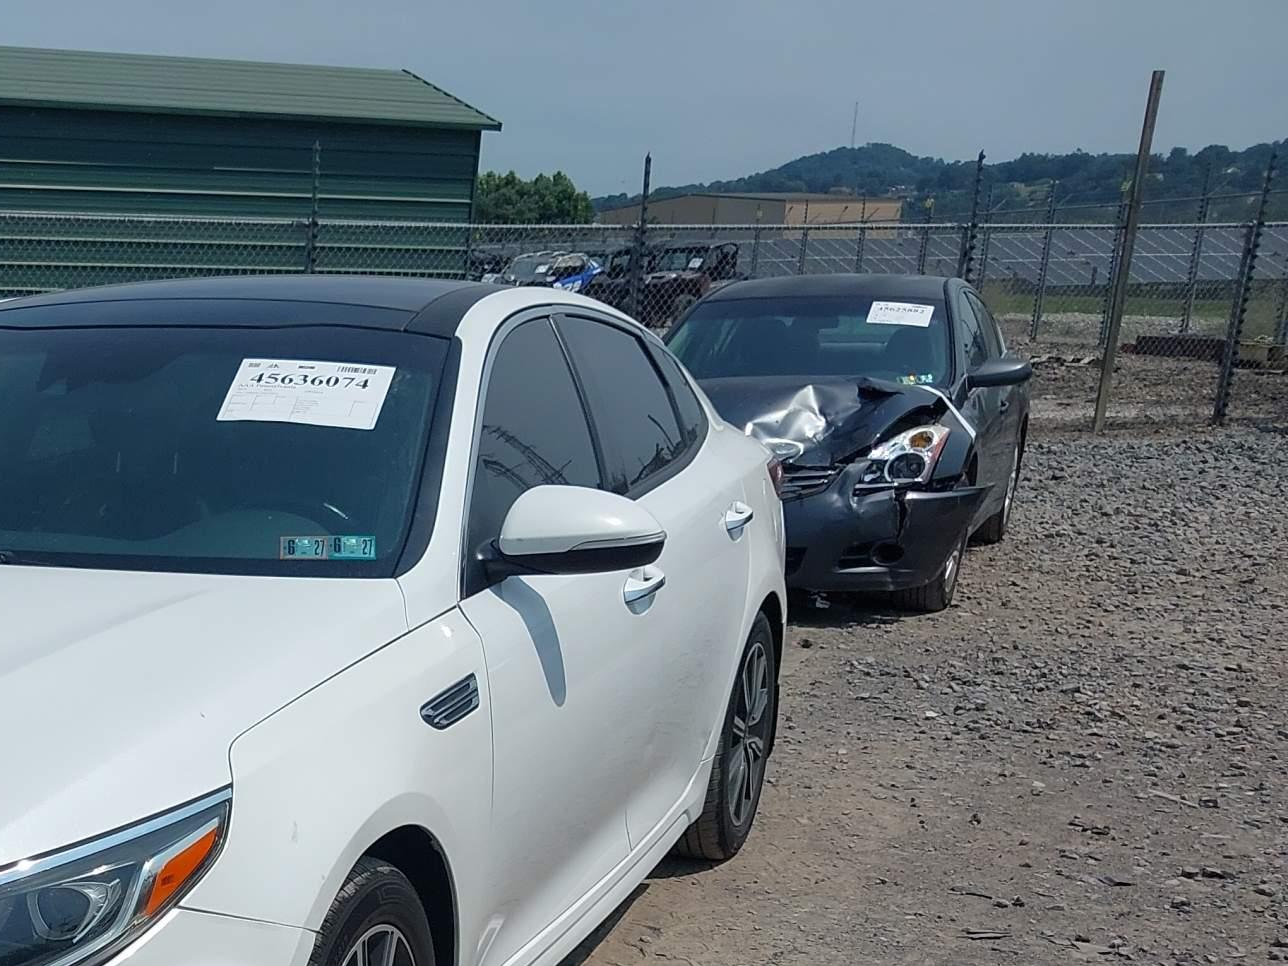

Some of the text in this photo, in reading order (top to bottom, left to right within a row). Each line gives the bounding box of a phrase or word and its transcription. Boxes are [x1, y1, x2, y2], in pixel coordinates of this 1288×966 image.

[250, 372, 369, 389] 45636074
[287, 539, 325, 557] 6 27
[333, 537, 373, 556] 6 27
